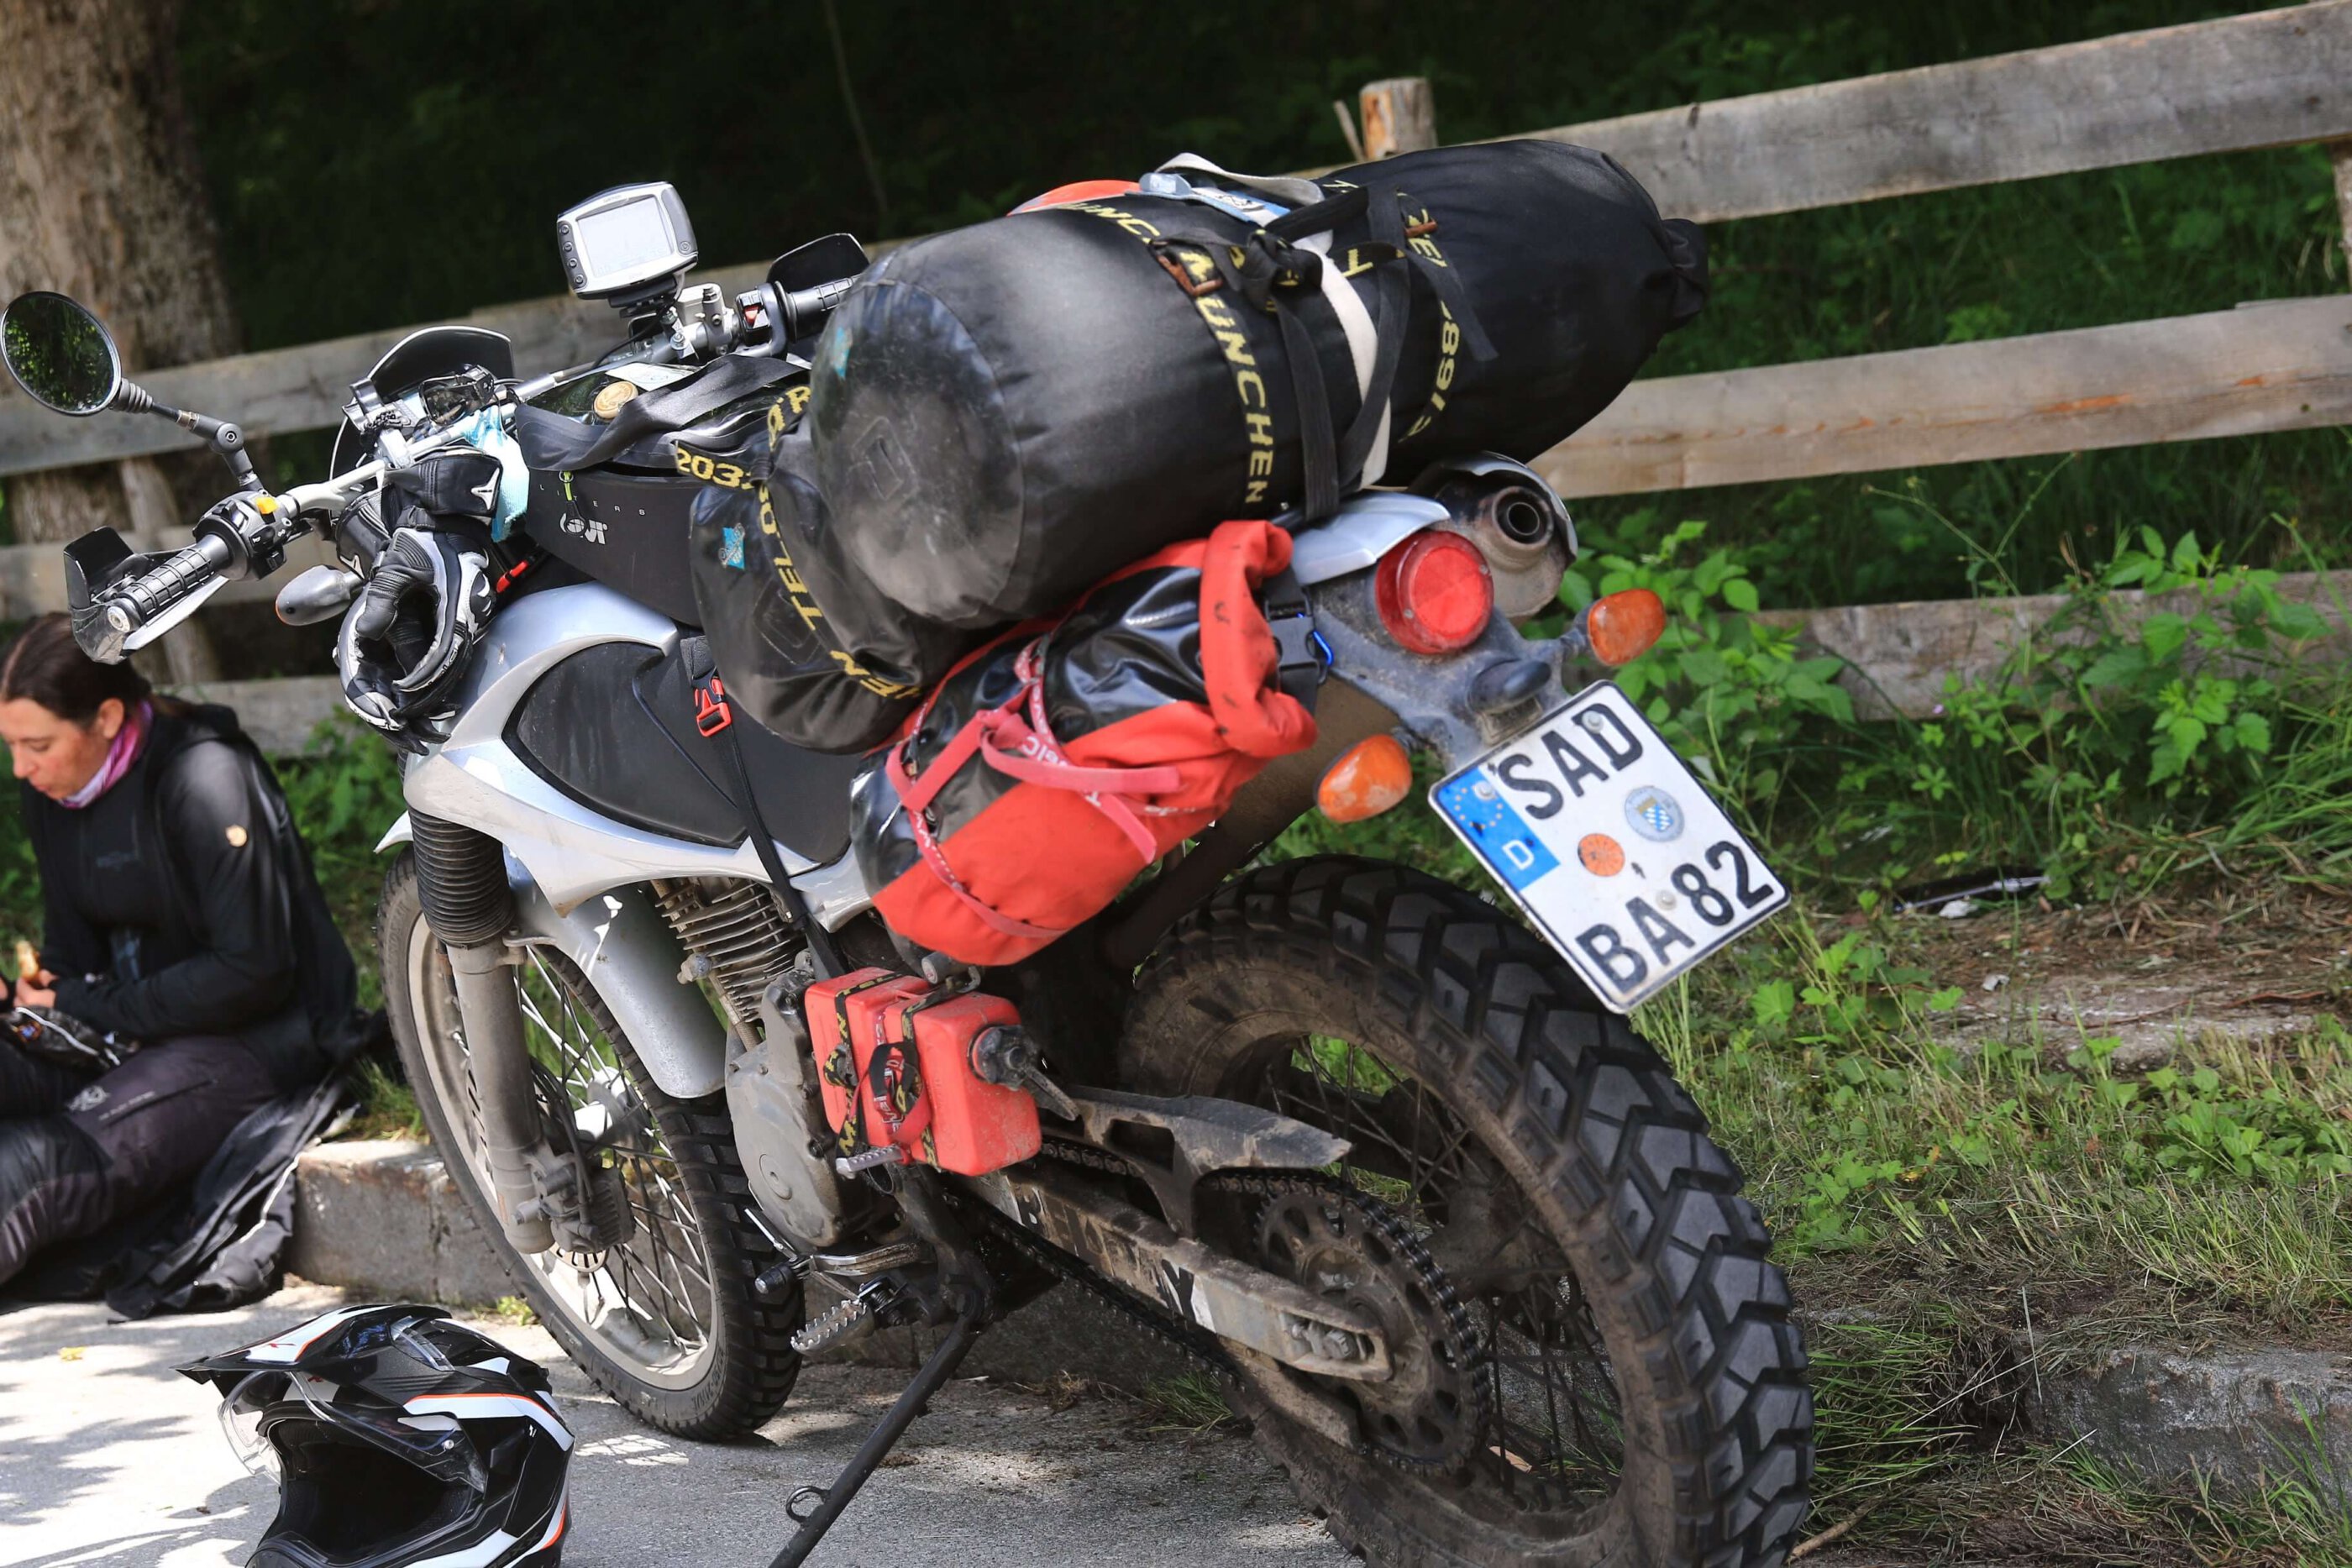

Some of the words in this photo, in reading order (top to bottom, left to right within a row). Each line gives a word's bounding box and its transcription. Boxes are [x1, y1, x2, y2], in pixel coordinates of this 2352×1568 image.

[1498, 703, 1643, 820] SAD
[1503, 839, 1535, 870] D
[1575, 896, 1696, 994] BA
[1671, 840, 1774, 927] 82
